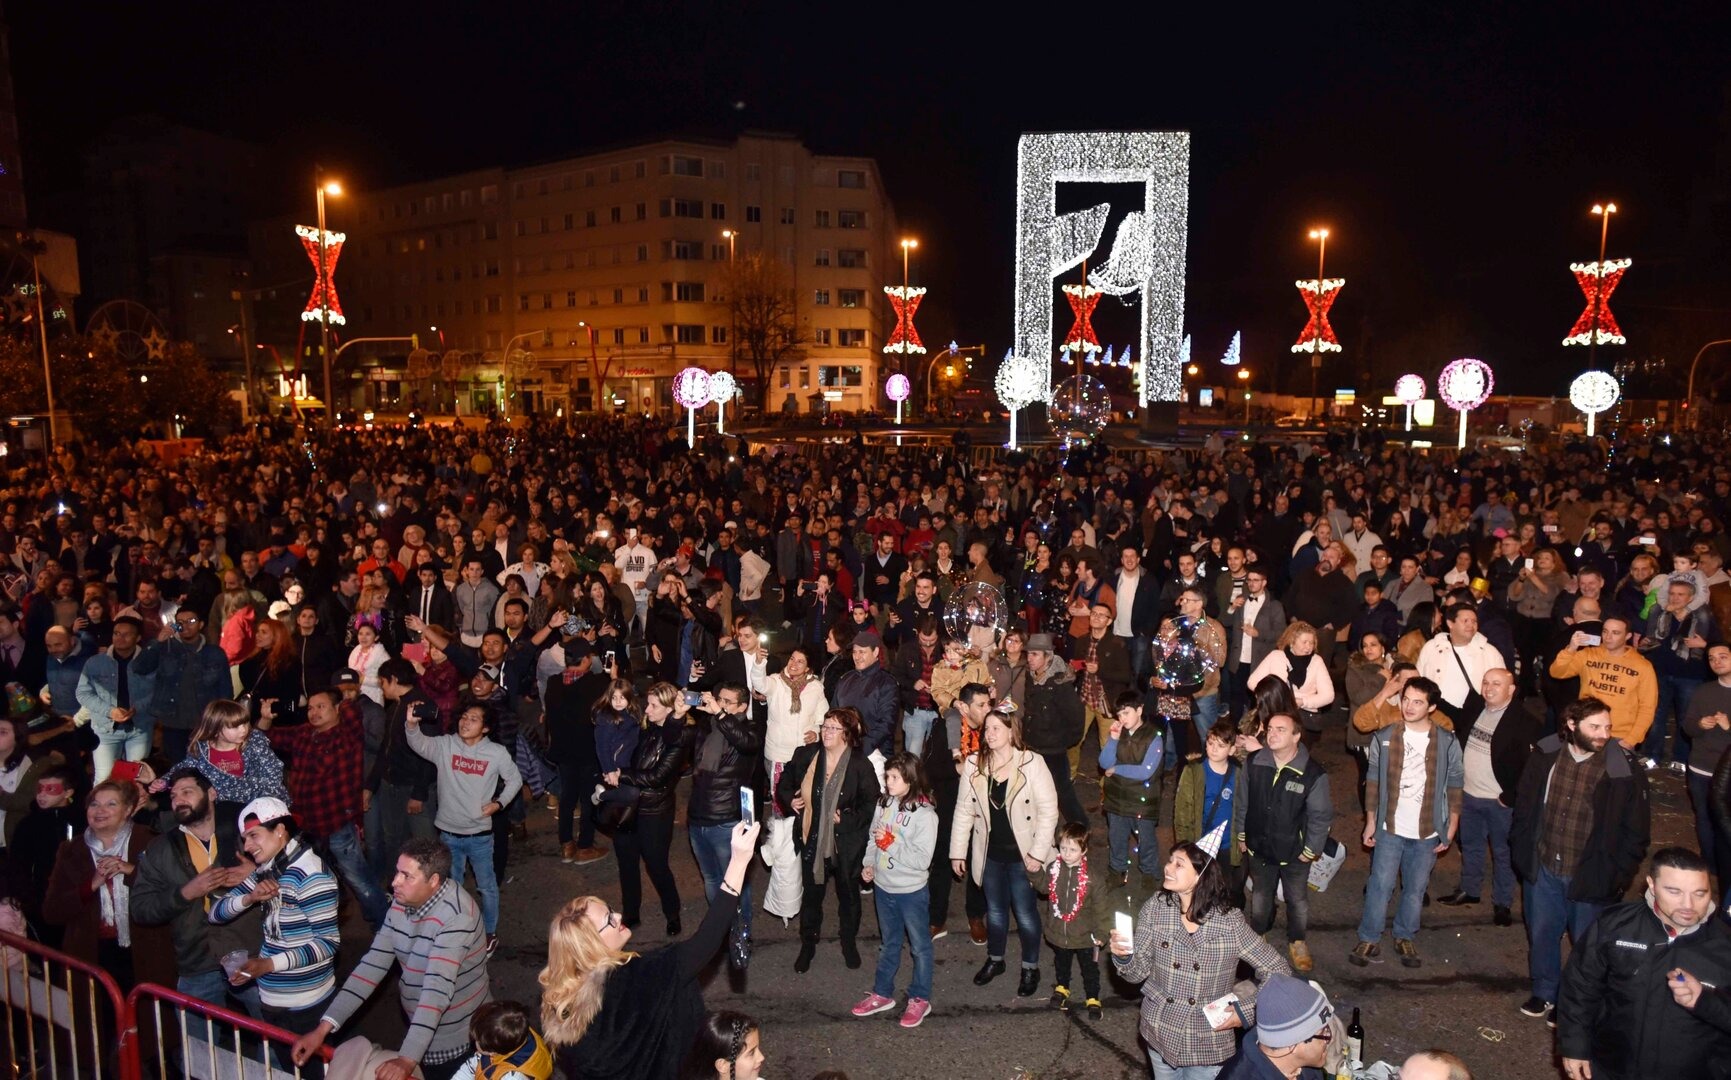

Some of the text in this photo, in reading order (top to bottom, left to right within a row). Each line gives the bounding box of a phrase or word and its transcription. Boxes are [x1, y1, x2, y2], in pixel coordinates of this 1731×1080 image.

[1613, 664, 1639, 677] STOP
[1600, 672, 1619, 683] THE
[1589, 679, 1626, 695] HUSTLE
